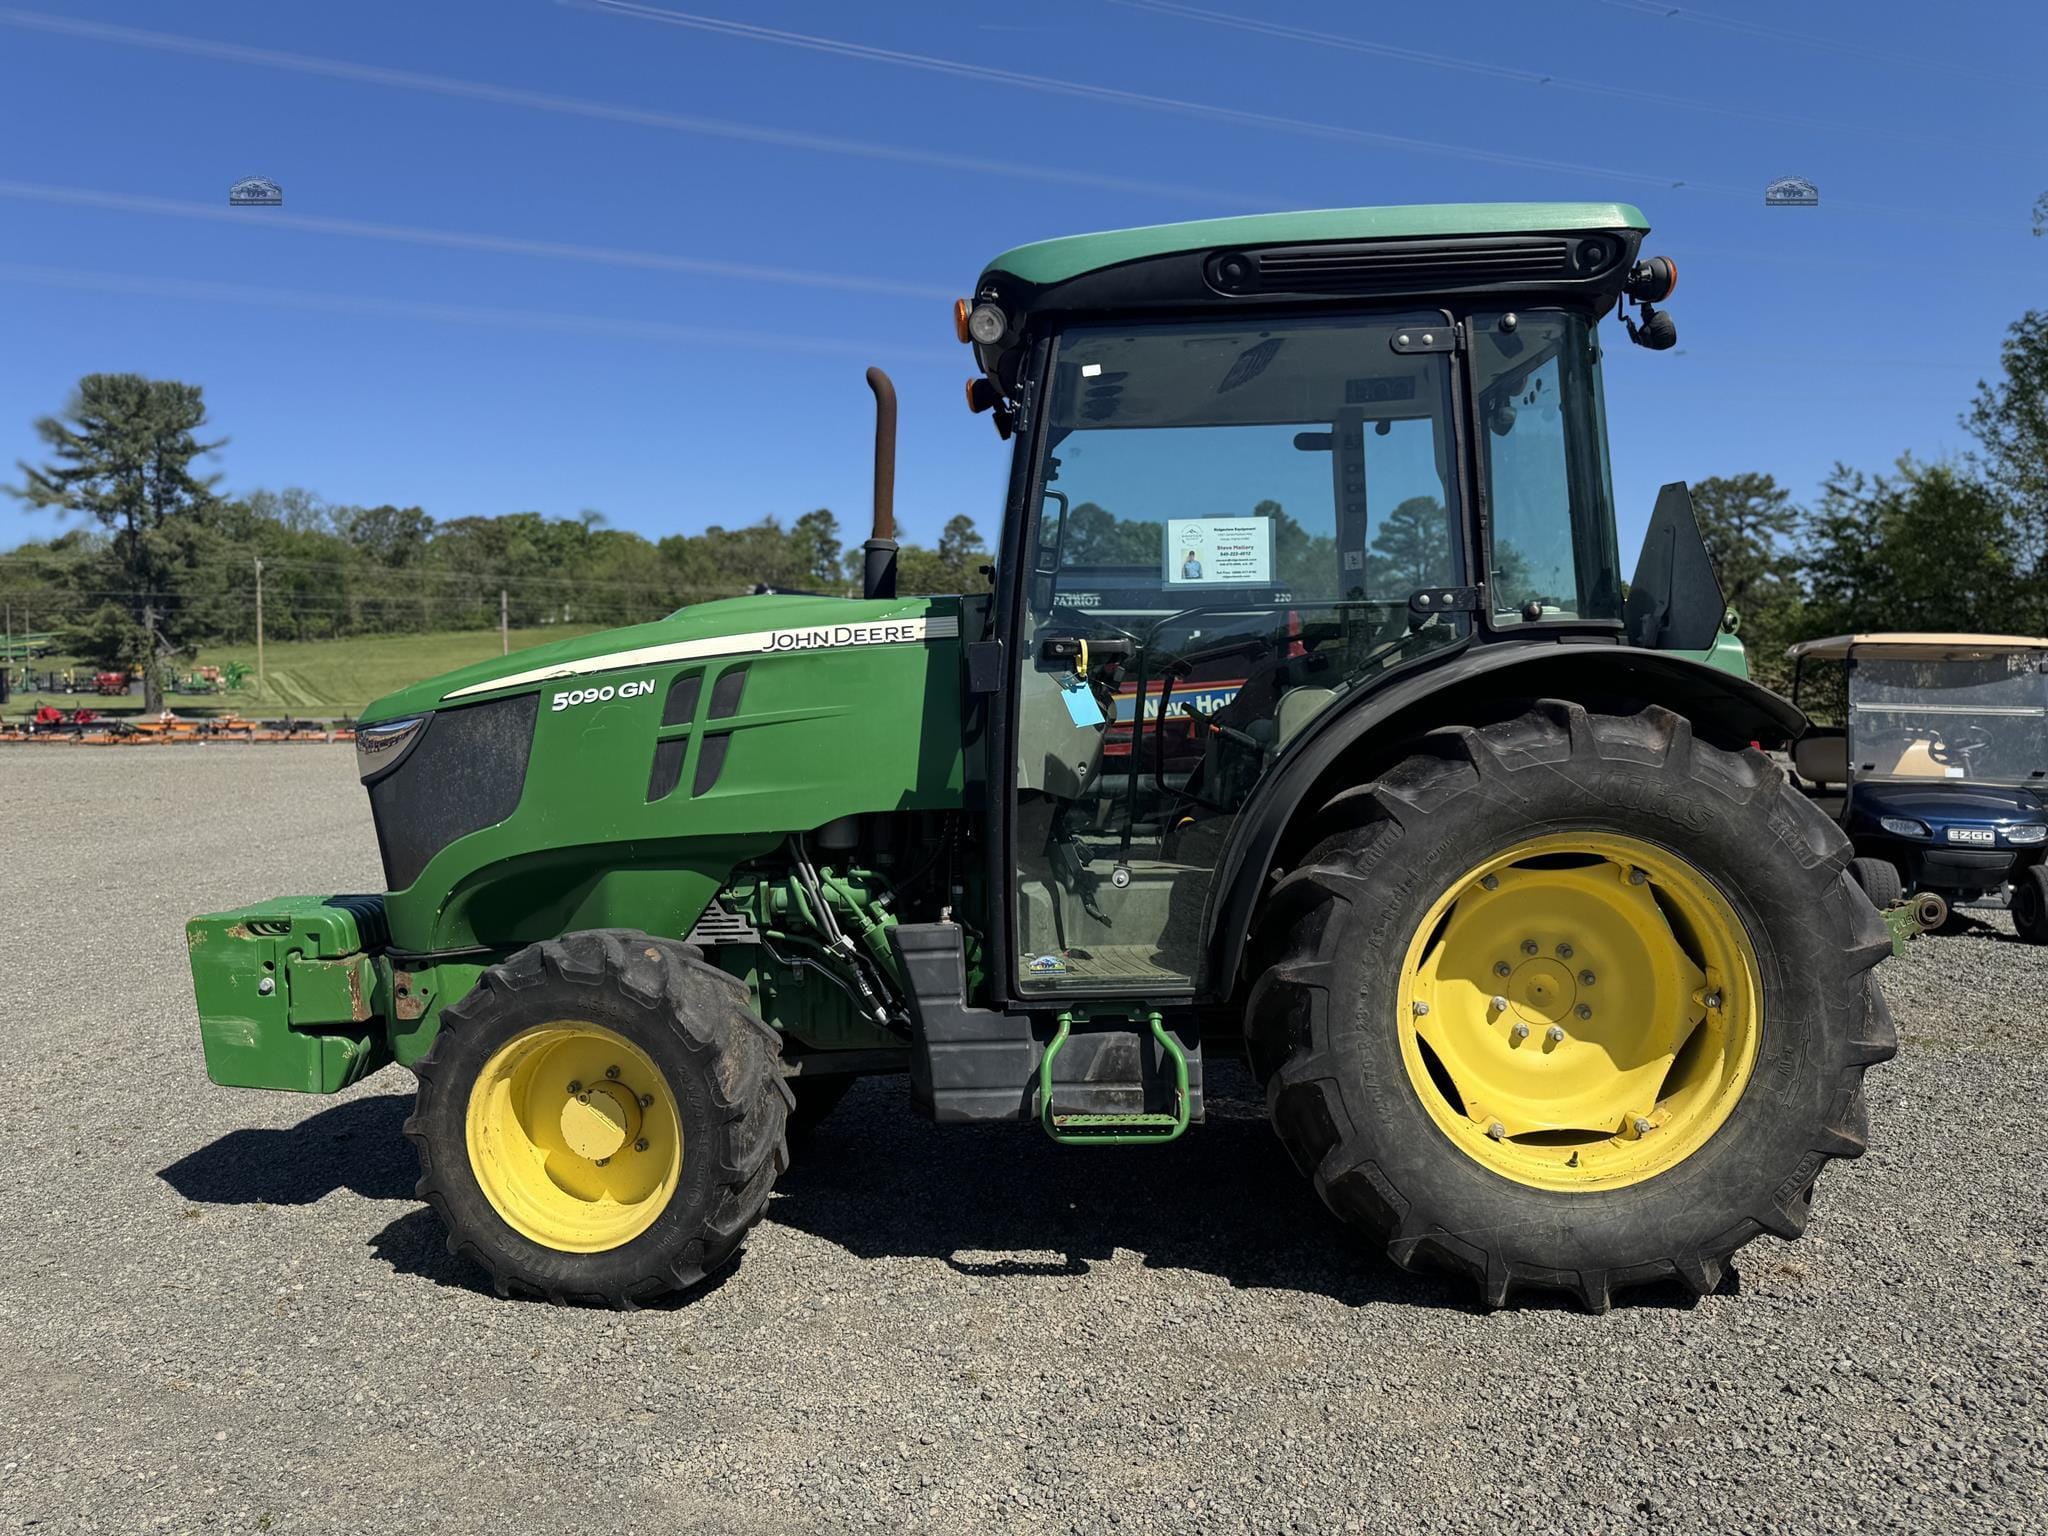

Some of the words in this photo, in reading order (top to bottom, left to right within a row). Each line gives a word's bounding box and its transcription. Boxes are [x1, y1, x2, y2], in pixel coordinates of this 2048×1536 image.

[1053, 596, 1101, 606] PATRIOT
[1274, 593, 1292, 603] 220
[762, 629, 829, 652] JOHN
[834, 625, 915, 647] DEERE
[551, 684, 613, 712] 5090
[618, 680, 657, 699] GN
